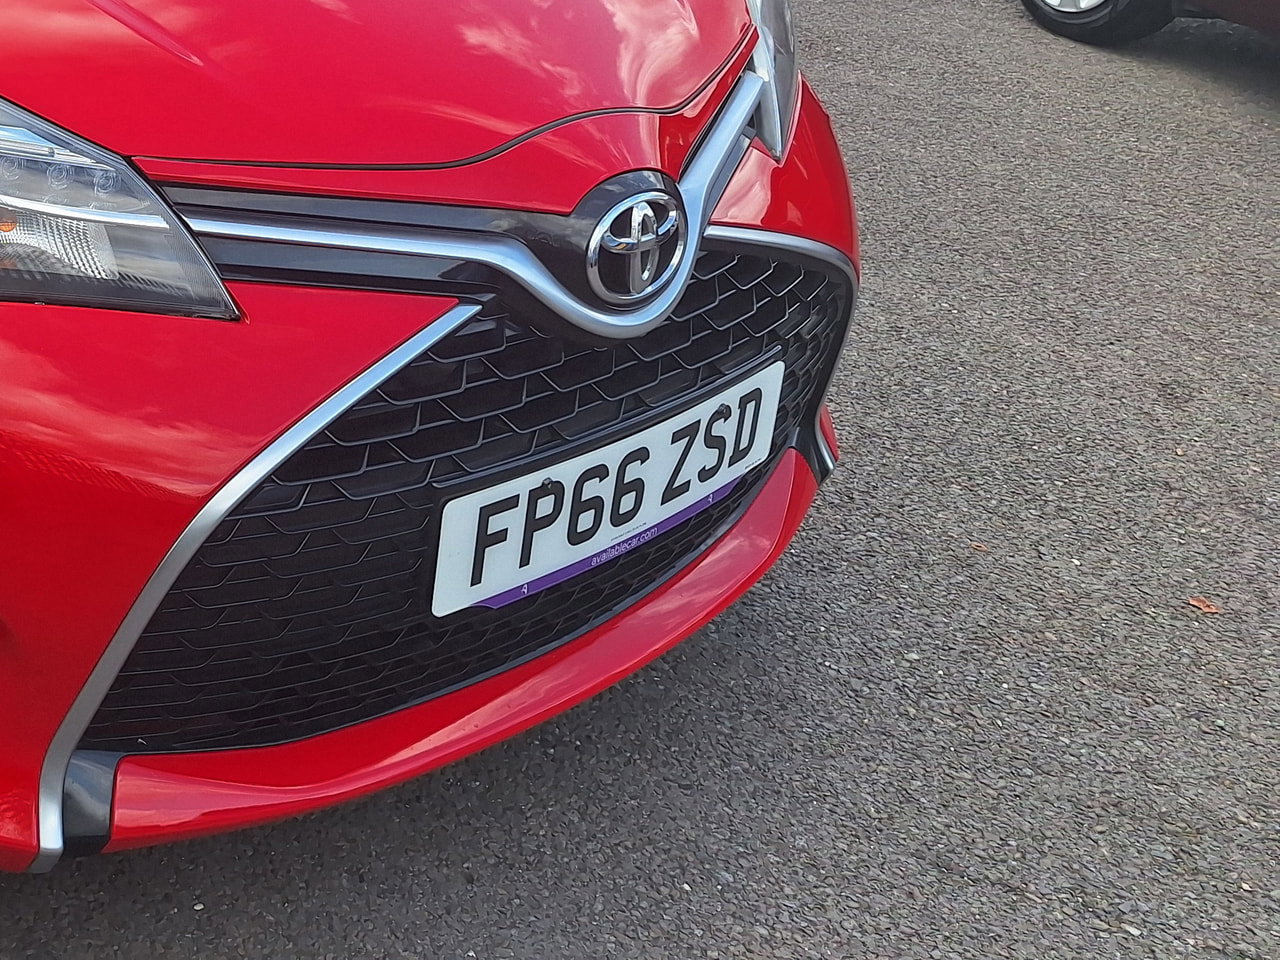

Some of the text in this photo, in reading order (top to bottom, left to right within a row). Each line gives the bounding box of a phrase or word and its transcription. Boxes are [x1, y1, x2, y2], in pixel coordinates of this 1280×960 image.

[470, 386, 764, 588] FP66 ZSD
[591, 527, 658, 566] availablecar.com
